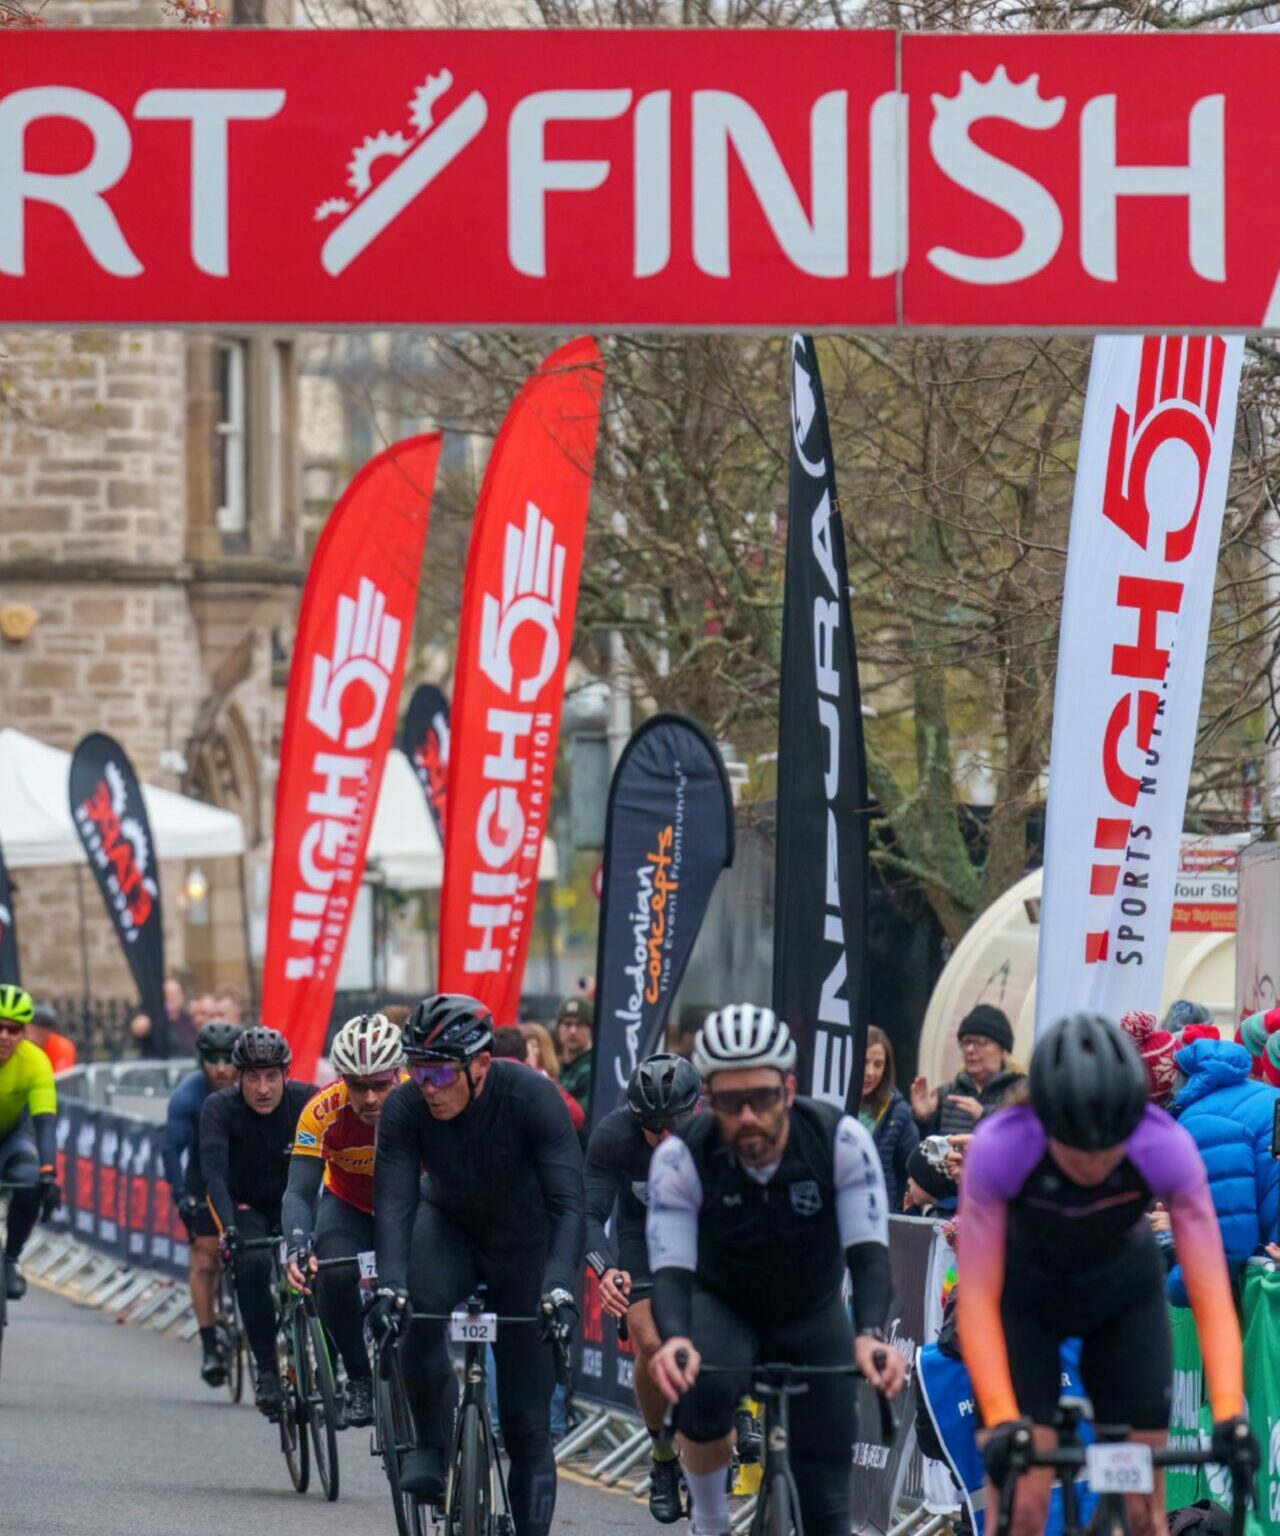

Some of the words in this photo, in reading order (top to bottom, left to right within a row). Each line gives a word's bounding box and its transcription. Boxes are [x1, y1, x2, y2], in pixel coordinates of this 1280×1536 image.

[508, 65, 1225, 284] FINISH
[645, 825, 680, 1005] concepts
[1116, 824, 1153, 967] SPORTS
[1174, 883, 1207, 897] Tour
[1211, 883, 1238, 897] Sto
[613, 863, 656, 1090] Caledonian
[660, 956, 671, 992] The
[461, 1326, 488, 1339] 102
